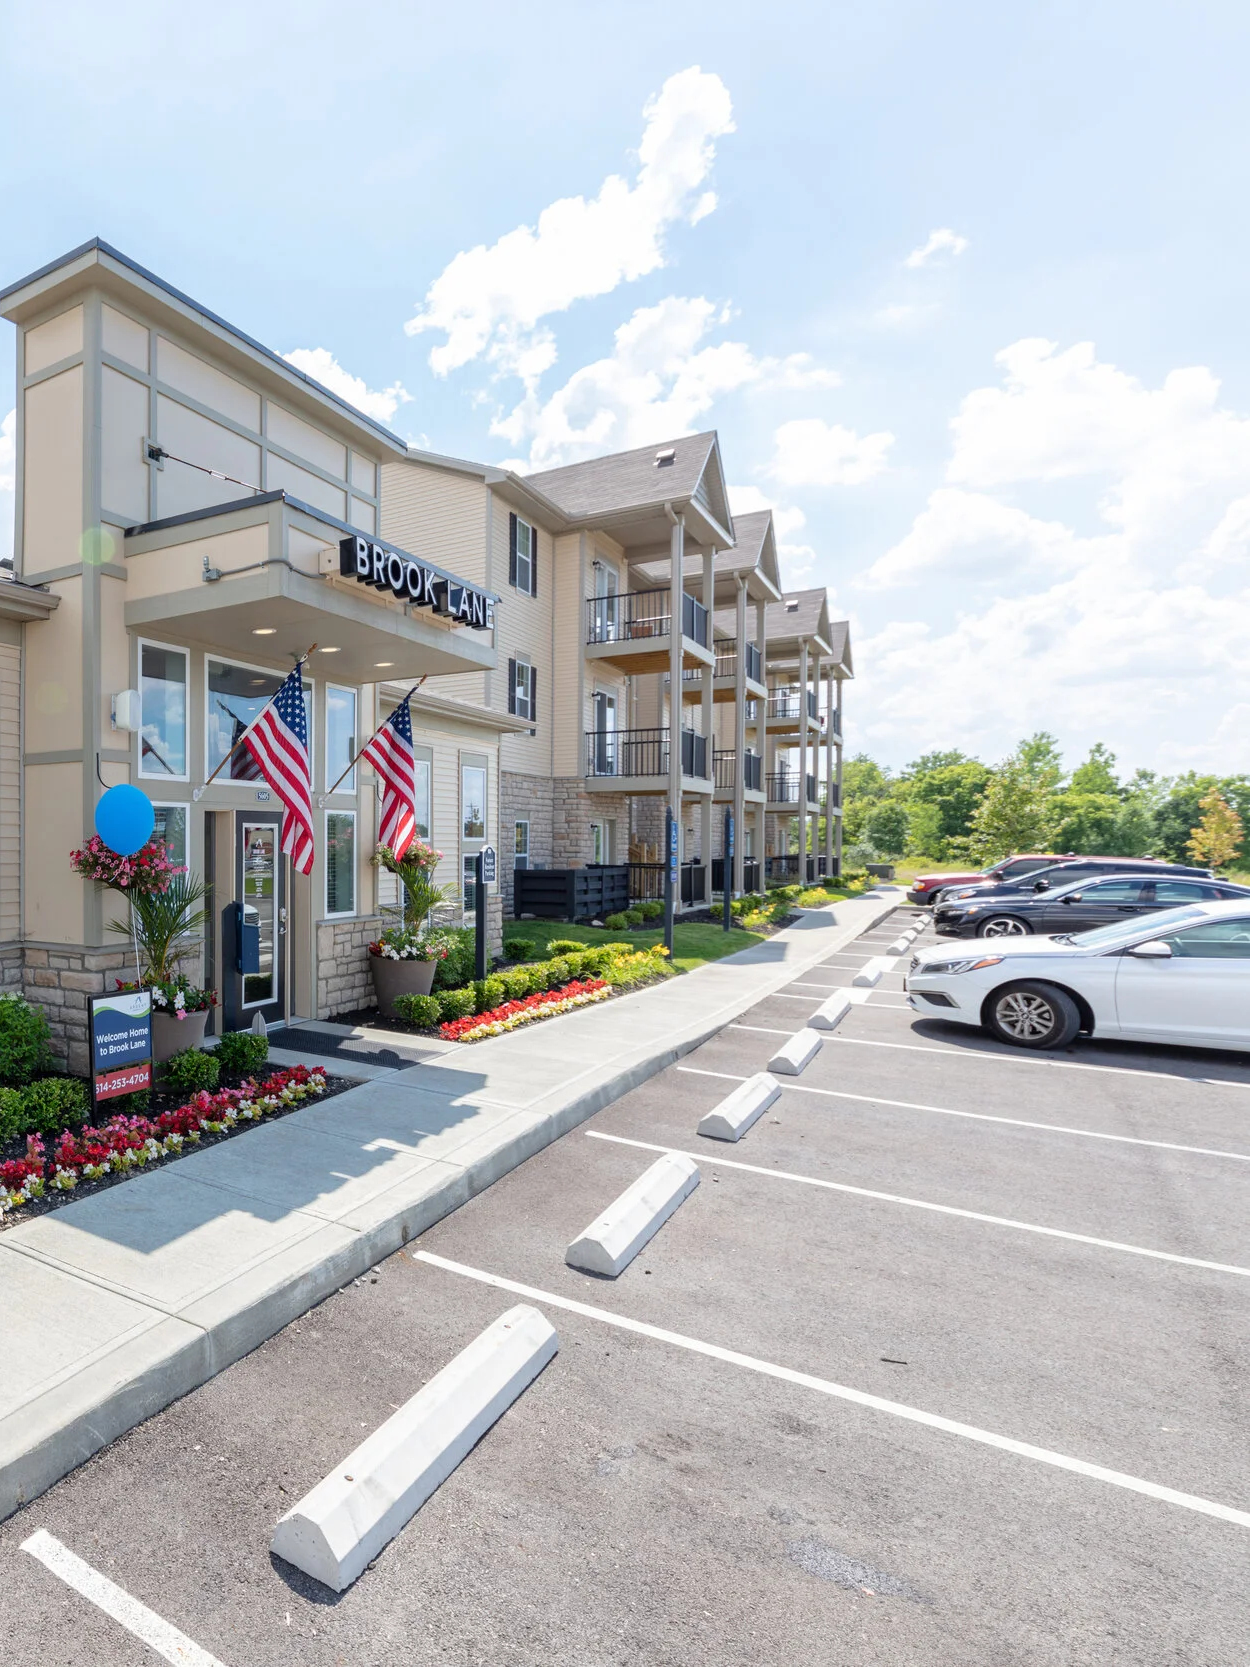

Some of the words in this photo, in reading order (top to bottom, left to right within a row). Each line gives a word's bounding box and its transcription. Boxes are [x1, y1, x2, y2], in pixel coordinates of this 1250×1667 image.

[356, 536, 438, 605] BROOK
[447, 579, 495, 630] LANE
[96, 1031, 129, 1044] Welcome
[129, 1027, 149, 1038] Home
[100, 1047, 108, 1056] to
[109, 1042, 129, 1054] Brook
[130, 1039, 146, 1049] Lane
